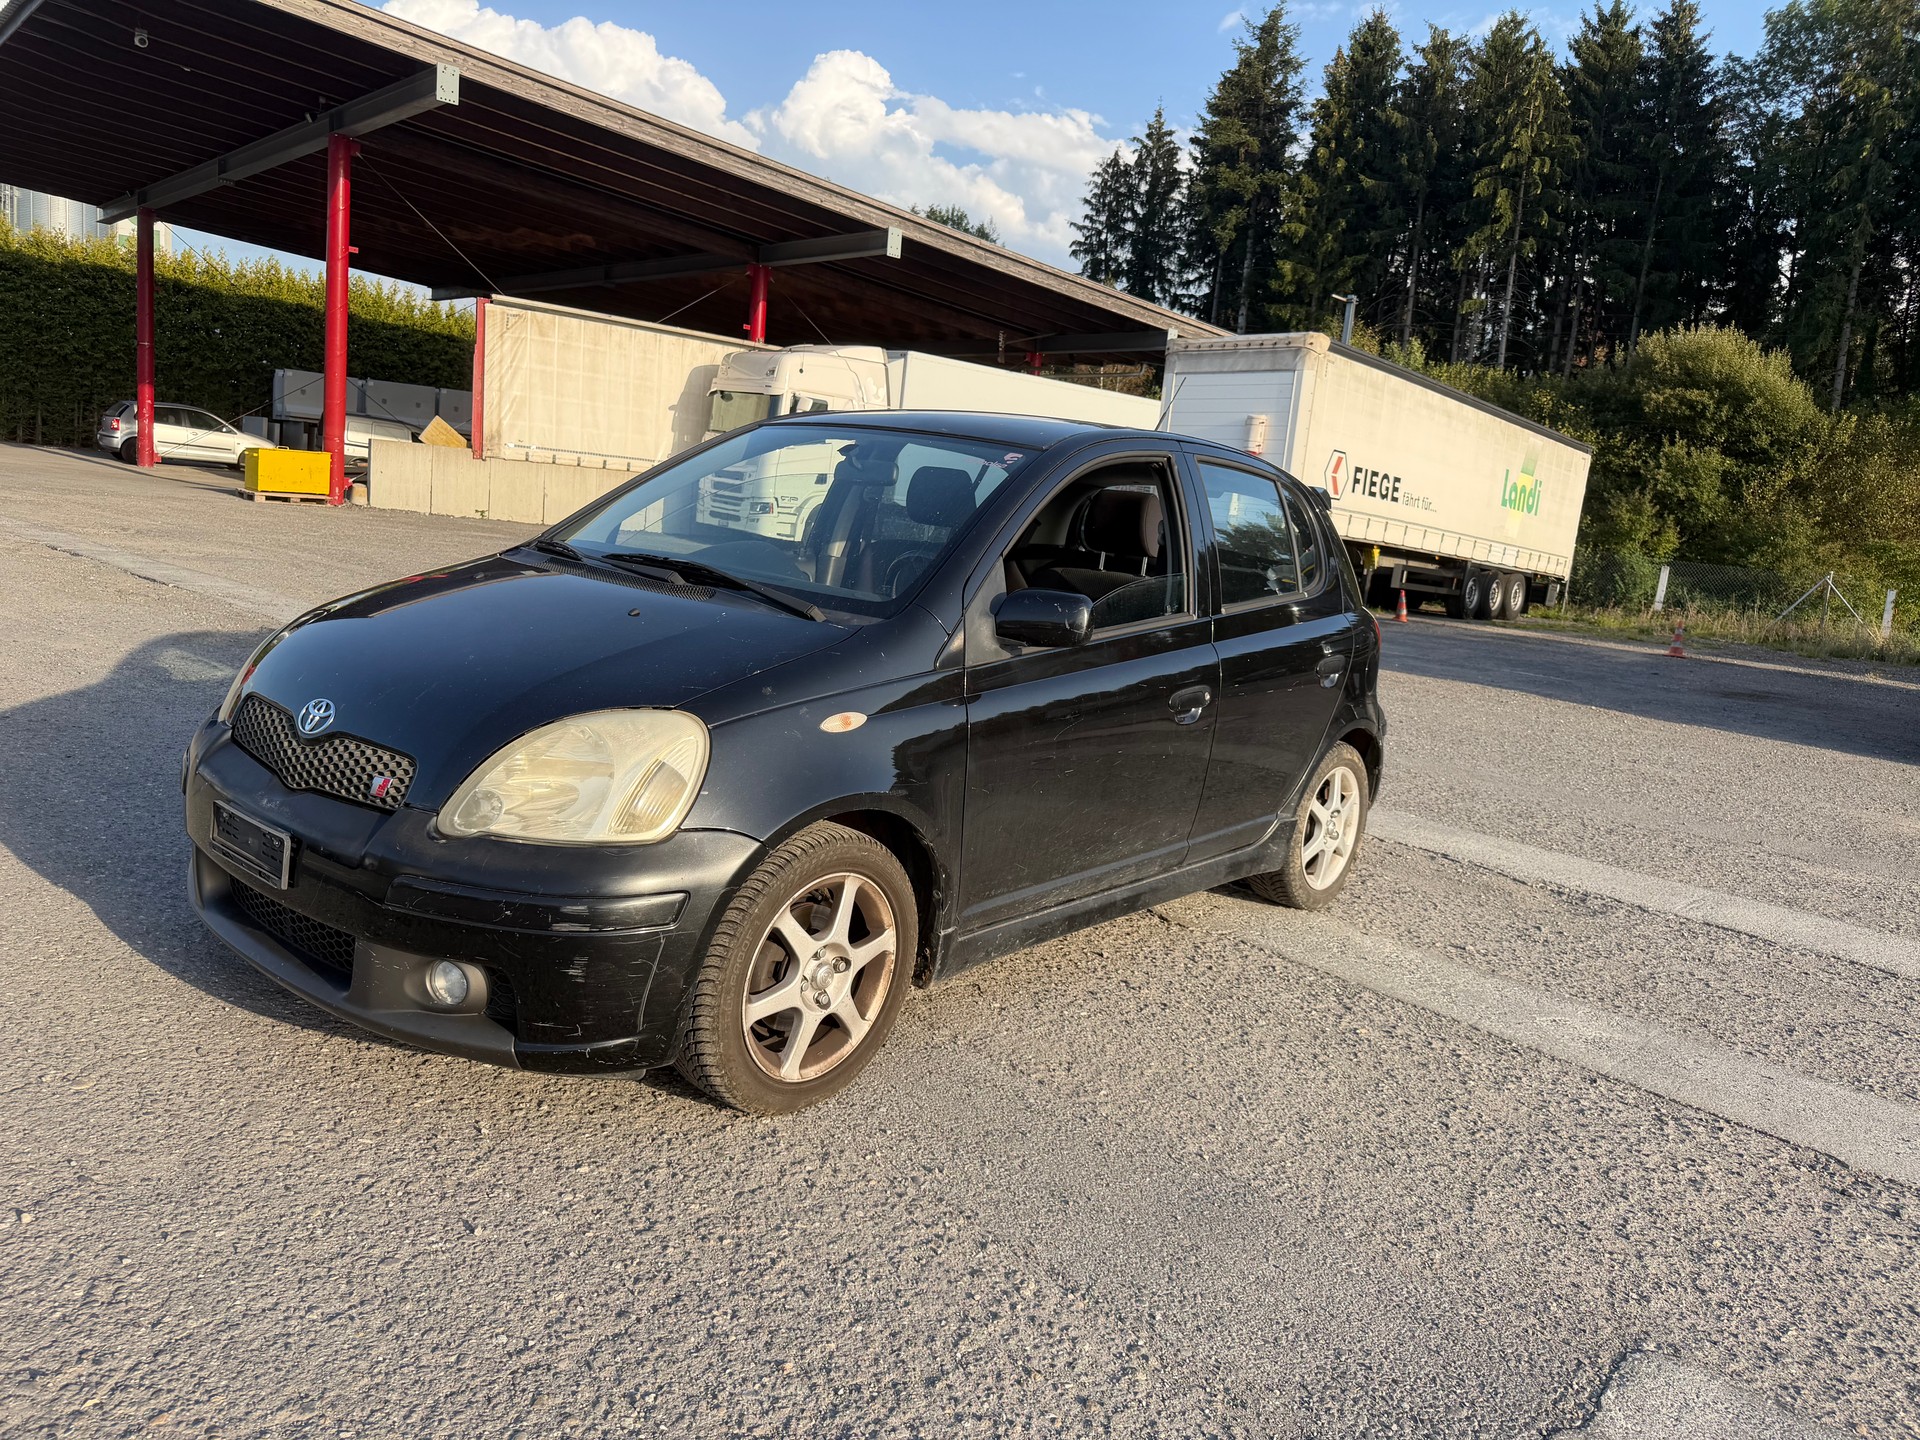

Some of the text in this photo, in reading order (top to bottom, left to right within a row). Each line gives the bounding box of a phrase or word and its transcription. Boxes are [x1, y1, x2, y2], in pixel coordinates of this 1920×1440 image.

[1352, 466, 1401, 503] FIEGE
[1402, 491, 1420, 509] fährt
[1501, 469, 1542, 516] Landi
